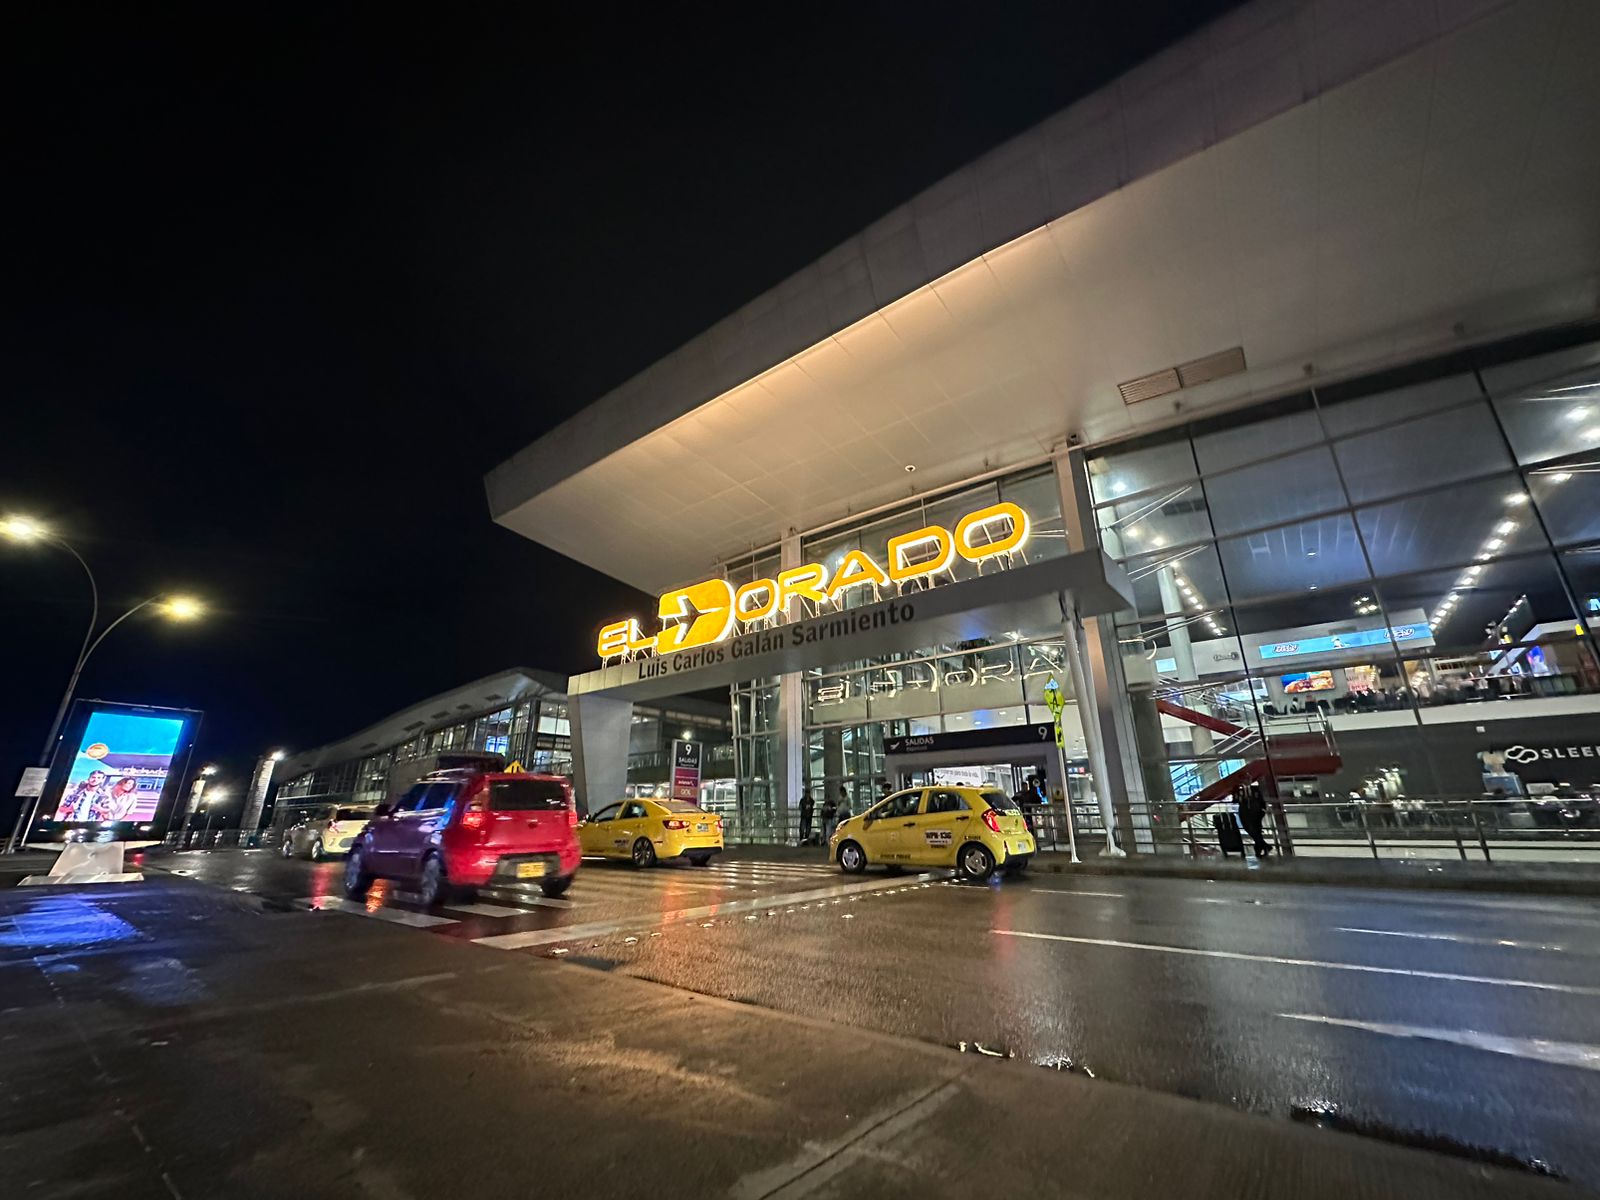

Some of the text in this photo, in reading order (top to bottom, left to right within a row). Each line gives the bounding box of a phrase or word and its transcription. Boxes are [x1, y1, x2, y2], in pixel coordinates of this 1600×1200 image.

[597, 502, 1031, 658] EL DORADO
[638, 602, 915, 680] Luis Carlos Galán Sarmiento
[685, 744, 692, 755] 9
[905, 726, 1048, 746] SALIDAS 9
